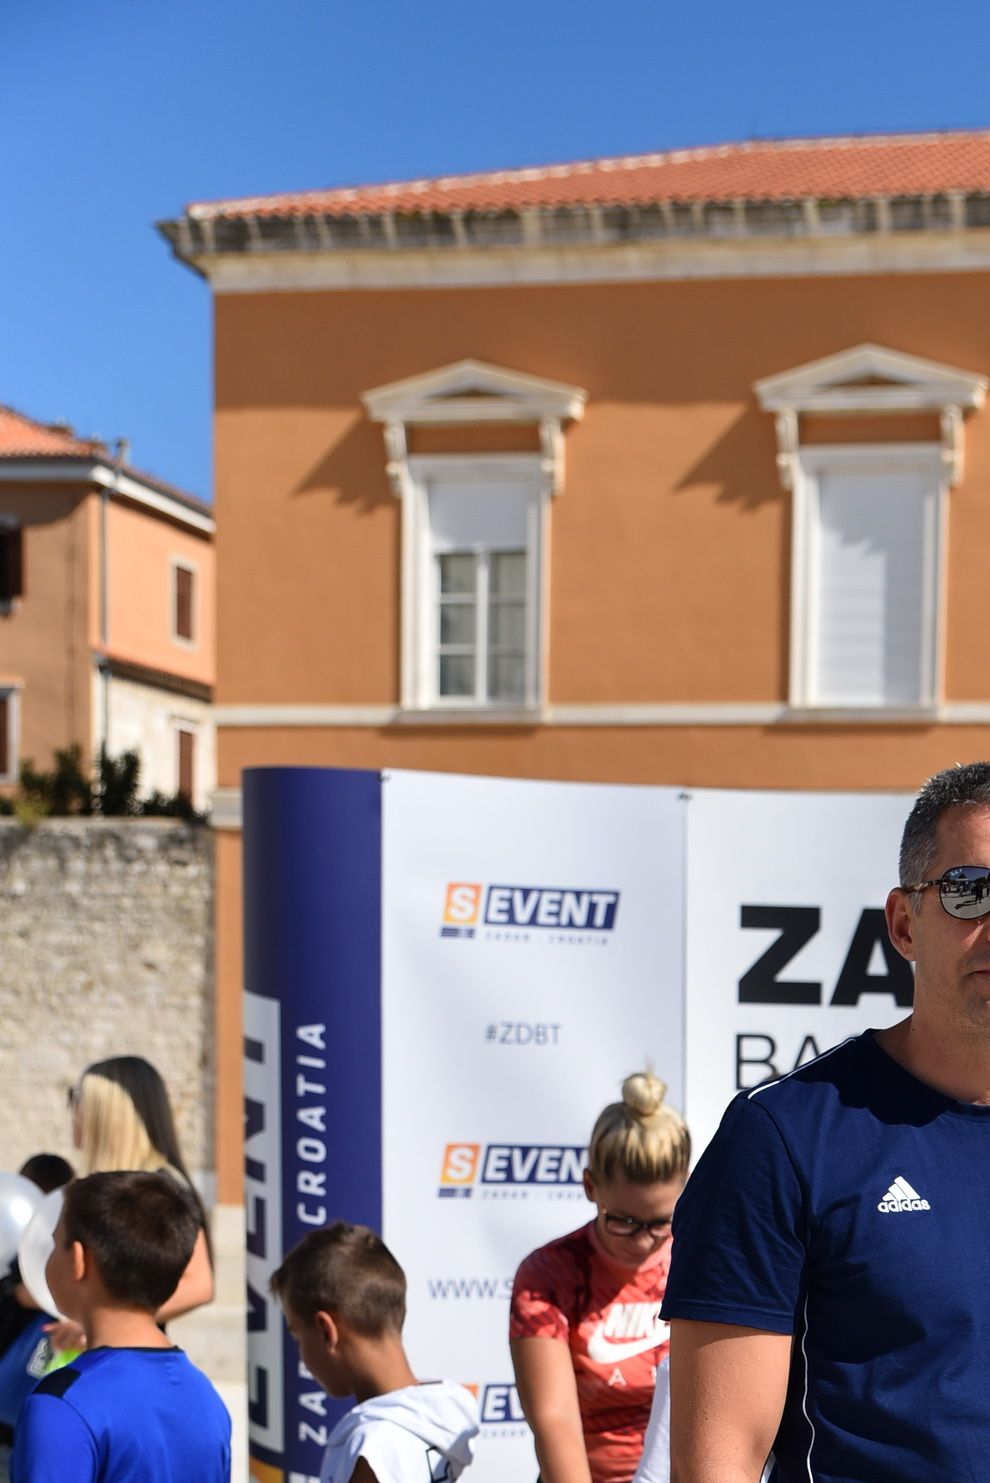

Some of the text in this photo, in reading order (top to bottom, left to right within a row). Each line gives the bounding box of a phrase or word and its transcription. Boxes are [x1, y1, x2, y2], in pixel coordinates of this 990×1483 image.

[296, 1023, 328, 1226] CROATIA
[484, 1147, 588, 1184] EVEN
[877, 1199, 931, 1213] adidas
